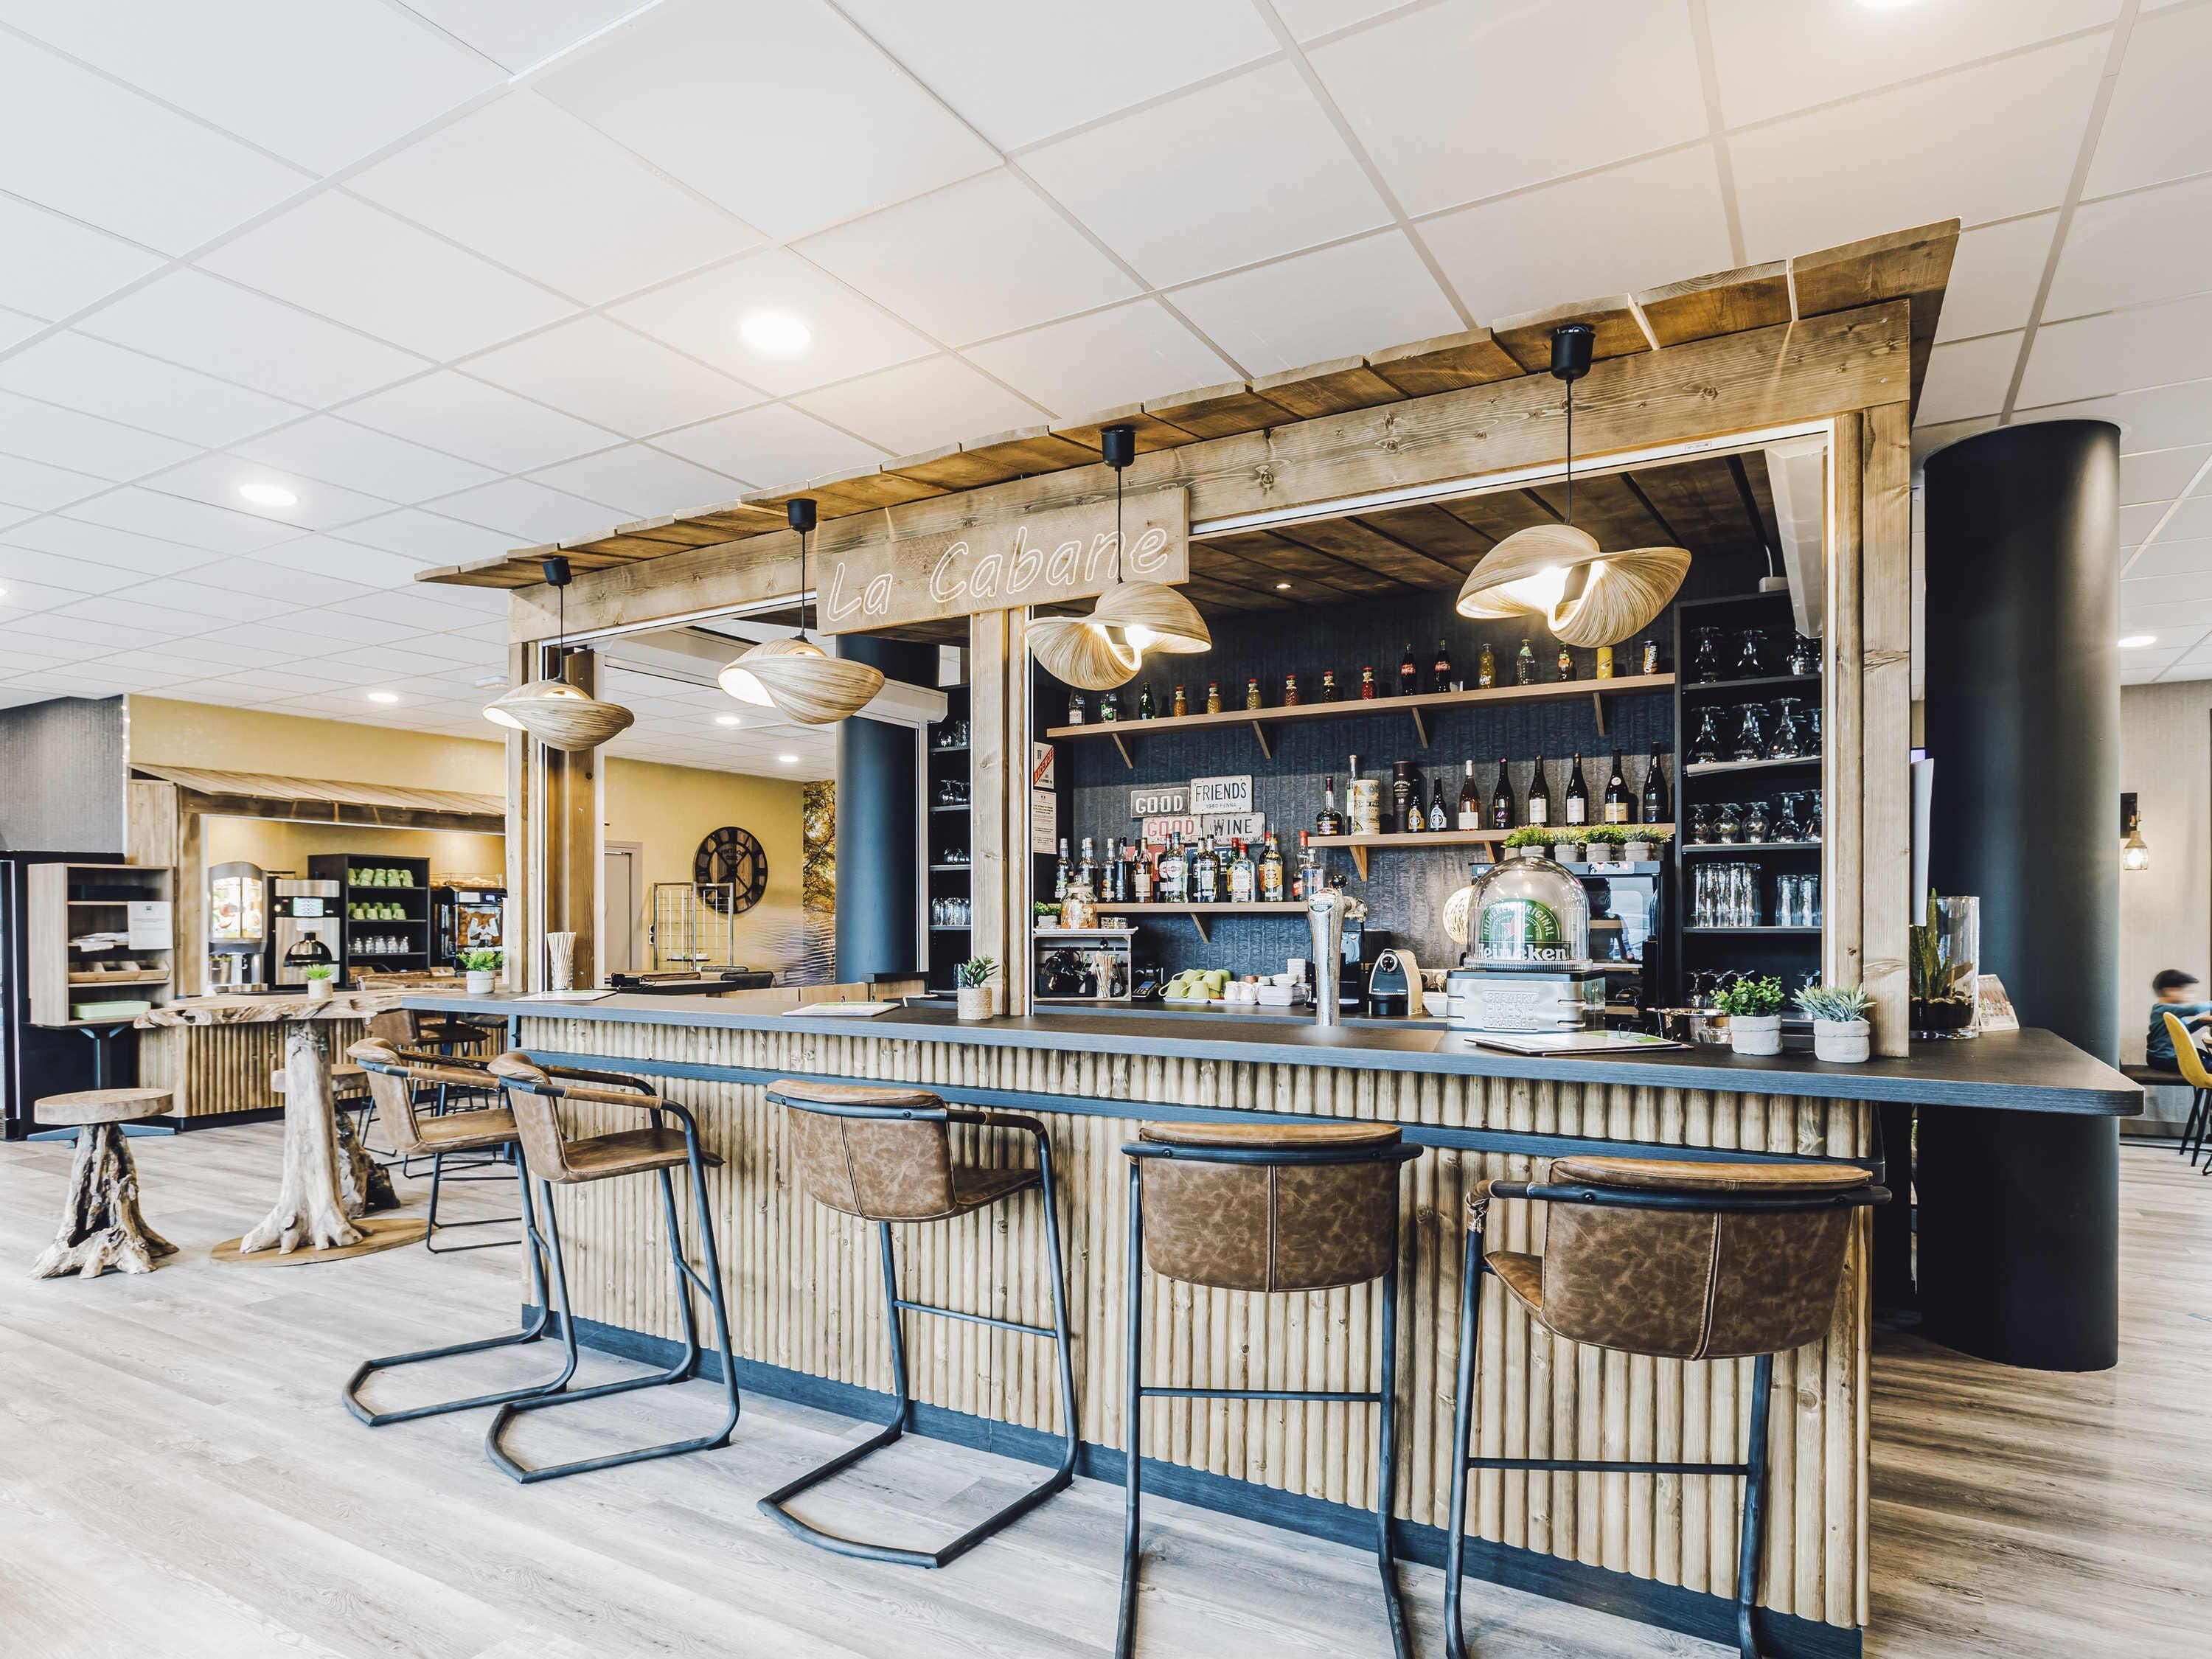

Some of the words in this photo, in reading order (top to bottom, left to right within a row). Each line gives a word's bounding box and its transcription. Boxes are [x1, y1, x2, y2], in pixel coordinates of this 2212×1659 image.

[827, 562, 894, 622] La
[928, 526, 1169, 604] Cabane
[1194, 782, 1248, 802] FRIENDS
[1135, 795, 1183, 814] GOOD
[1147, 819, 1194, 837] GOOD
[1213, 818, 1253, 836] WINE
[1525, 904, 1555, 937] RIGINAL
